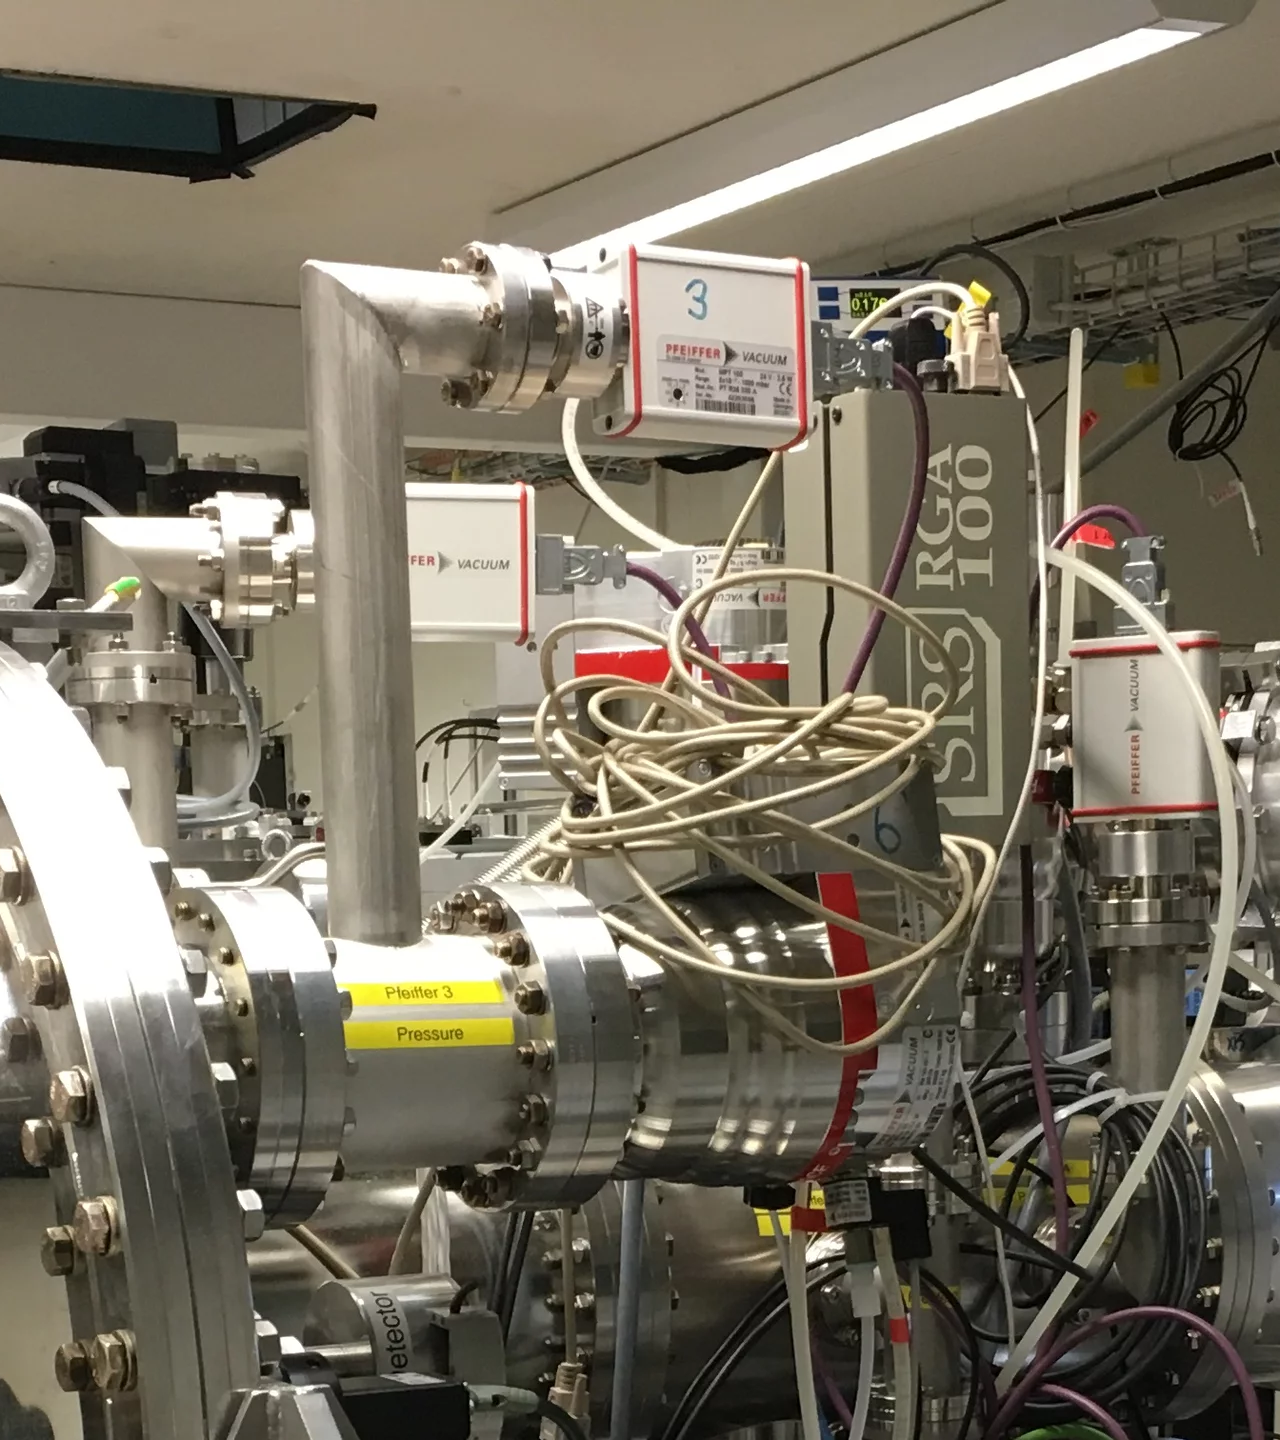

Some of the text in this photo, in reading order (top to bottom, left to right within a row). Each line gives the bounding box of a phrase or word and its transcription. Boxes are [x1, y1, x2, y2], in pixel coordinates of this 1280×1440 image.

[684, 278, 709, 321] 3
[665, 343, 721, 359] PFEIFFER
[742, 351, 788, 366] VACUUM
[916, 443, 994, 591] RGA 100
[408, 555, 510, 570] FER VACUUM
[919, 626, 976, 783] SRS
[1129, 658, 1141, 795] PFEIFFER VACUUM
[873, 804, 902, 855] 6
[384, 984, 454, 1001] Pfeiffer 3
[396, 1024, 464, 1043] Pressure
[905, 1036, 920, 1086] VACUUM
[371, 1291, 409, 1374] etector
